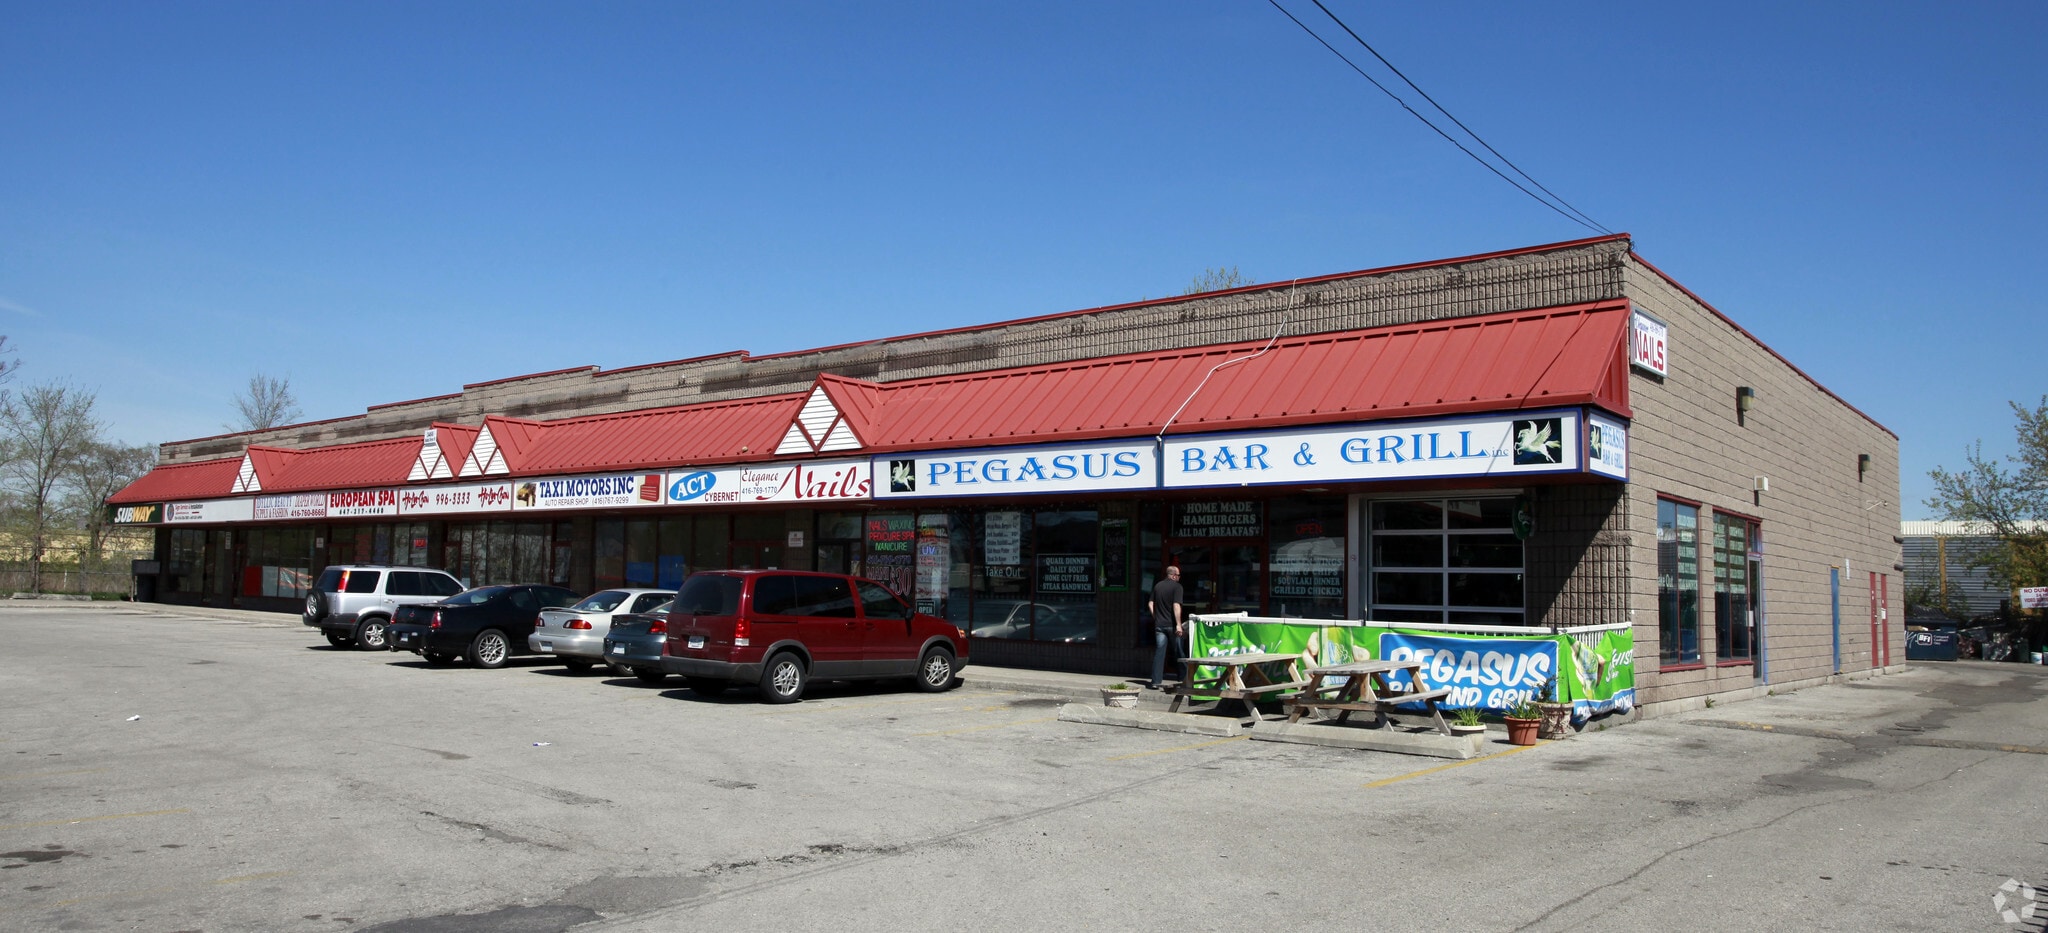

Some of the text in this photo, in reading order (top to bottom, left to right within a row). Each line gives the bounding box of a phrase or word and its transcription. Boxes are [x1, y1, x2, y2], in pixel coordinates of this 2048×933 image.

[1635, 329, 1664, 371] NAILS
[1601, 424, 1625, 450] PEGASUS
[1181, 443, 1273, 473] BAR
[1293, 442, 1317, 466] &
[1340, 430, 1490, 463] GRILL
[928, 451, 1141, 486] PEGASUS
[540, 476, 635, 498] TAXI MOTORS INC
[676, 474, 708, 499] ACT
[742, 464, 871, 500] Elegance Nails
[330, 490, 396, 508] EUROPEAN SPA
[436, 492, 470, 505] 996-3333
[558, 498, 575, 506] REPAIR
[575, 497, 589, 505] SHOP
[704, 491, 739, 502] CYBERNET
[1187, 501, 1252, 513] HOME MADE
[114, 505, 155, 523] SUBWAY
[1183, 514, 1257, 525] HAMBURGERS
[868, 519, 915, 531] NAILS WAXING
[1295, 523, 1325, 535] OPEN
[868, 531, 900, 541] PEDICURE
[1178, 527, 1191, 537] ALL
[1193, 527, 1207, 537] DAY
[875, 542, 908, 551] MANICURE
[921, 546, 936, 555] UV
[1045, 557, 1089, 566] QUAIL DINNER
[985, 566, 1021, 577] Take Out
[1312, 567, 1338, 576] CHIPS
[1044, 574, 1089, 582] HOME CUT FRIES
[1277, 577, 1340, 585] SOUVLAKI DINNER
[1042, 583, 1092, 591] STEAK SANDWICH
[1274, 585, 1343, 595] GRILLED CHICKEN
[918, 606, 933, 614] OPEN
[1388, 647, 1550, 687] PEGASUS
